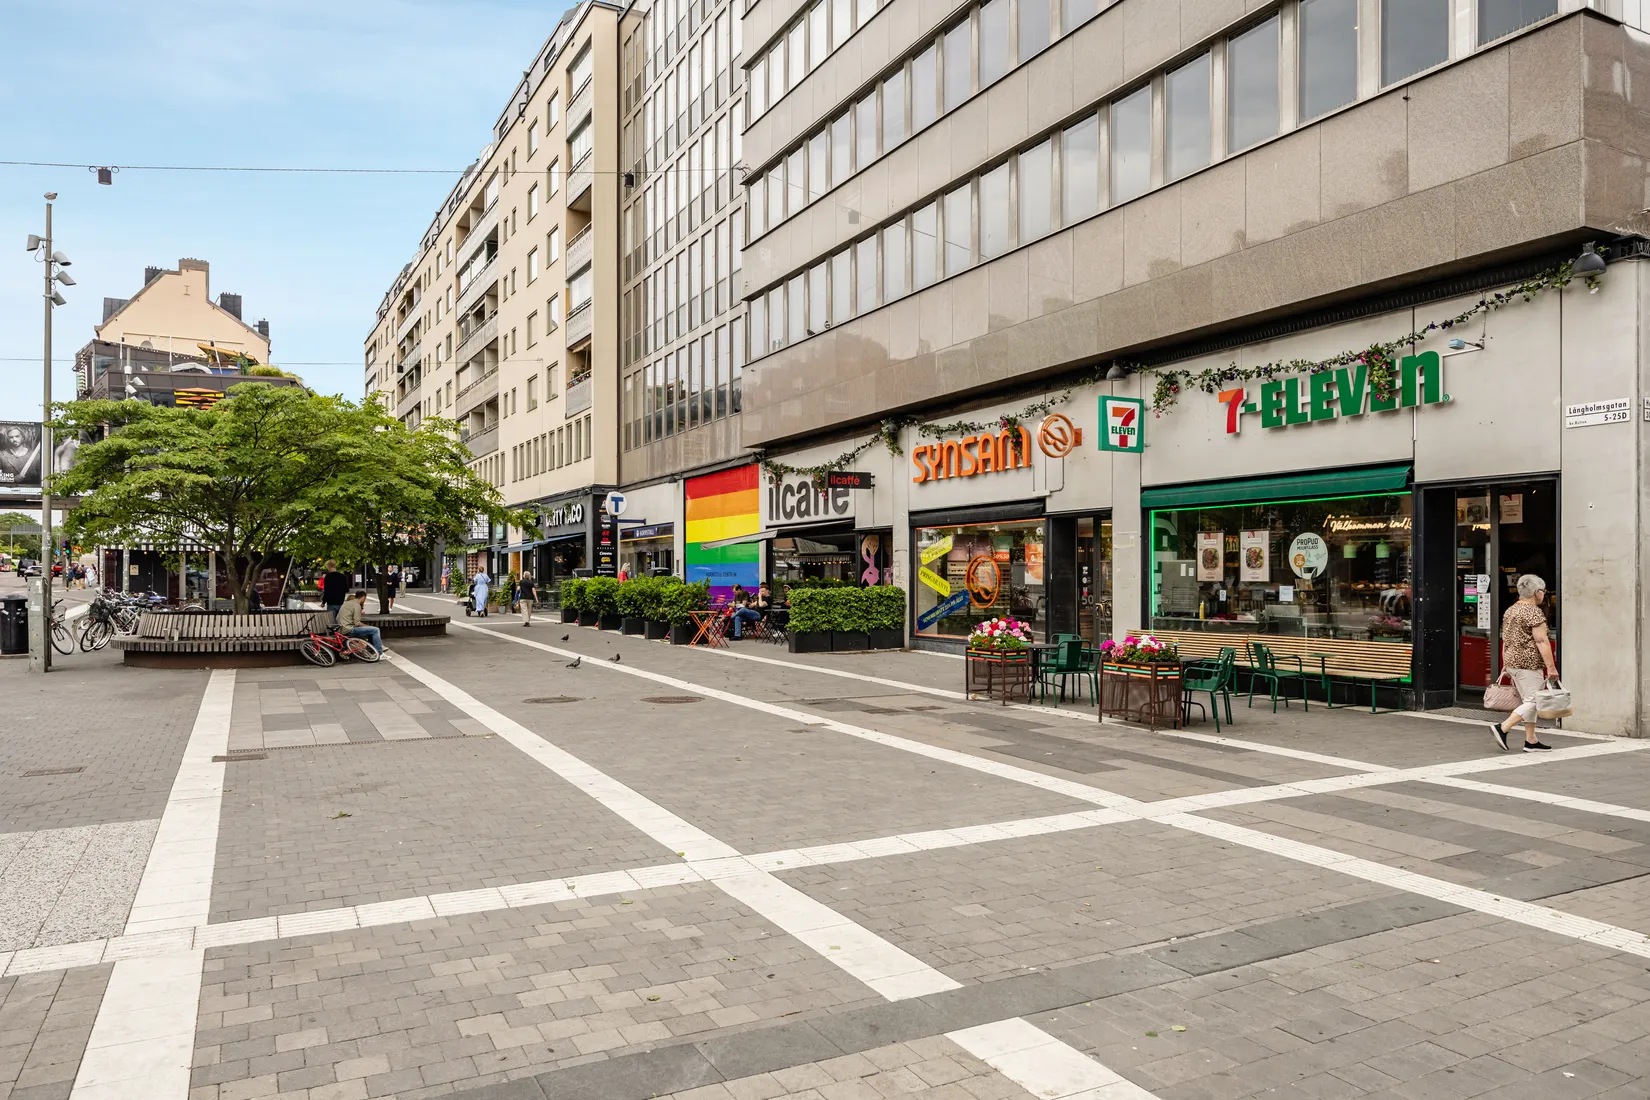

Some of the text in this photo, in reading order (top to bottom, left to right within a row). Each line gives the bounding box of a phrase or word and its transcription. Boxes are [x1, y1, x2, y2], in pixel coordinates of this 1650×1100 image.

[1569, 402, 1627, 415] Långholmsgatan
[912, 425, 1031, 483] SYNSAM
[611, 497, 624, 513] T
